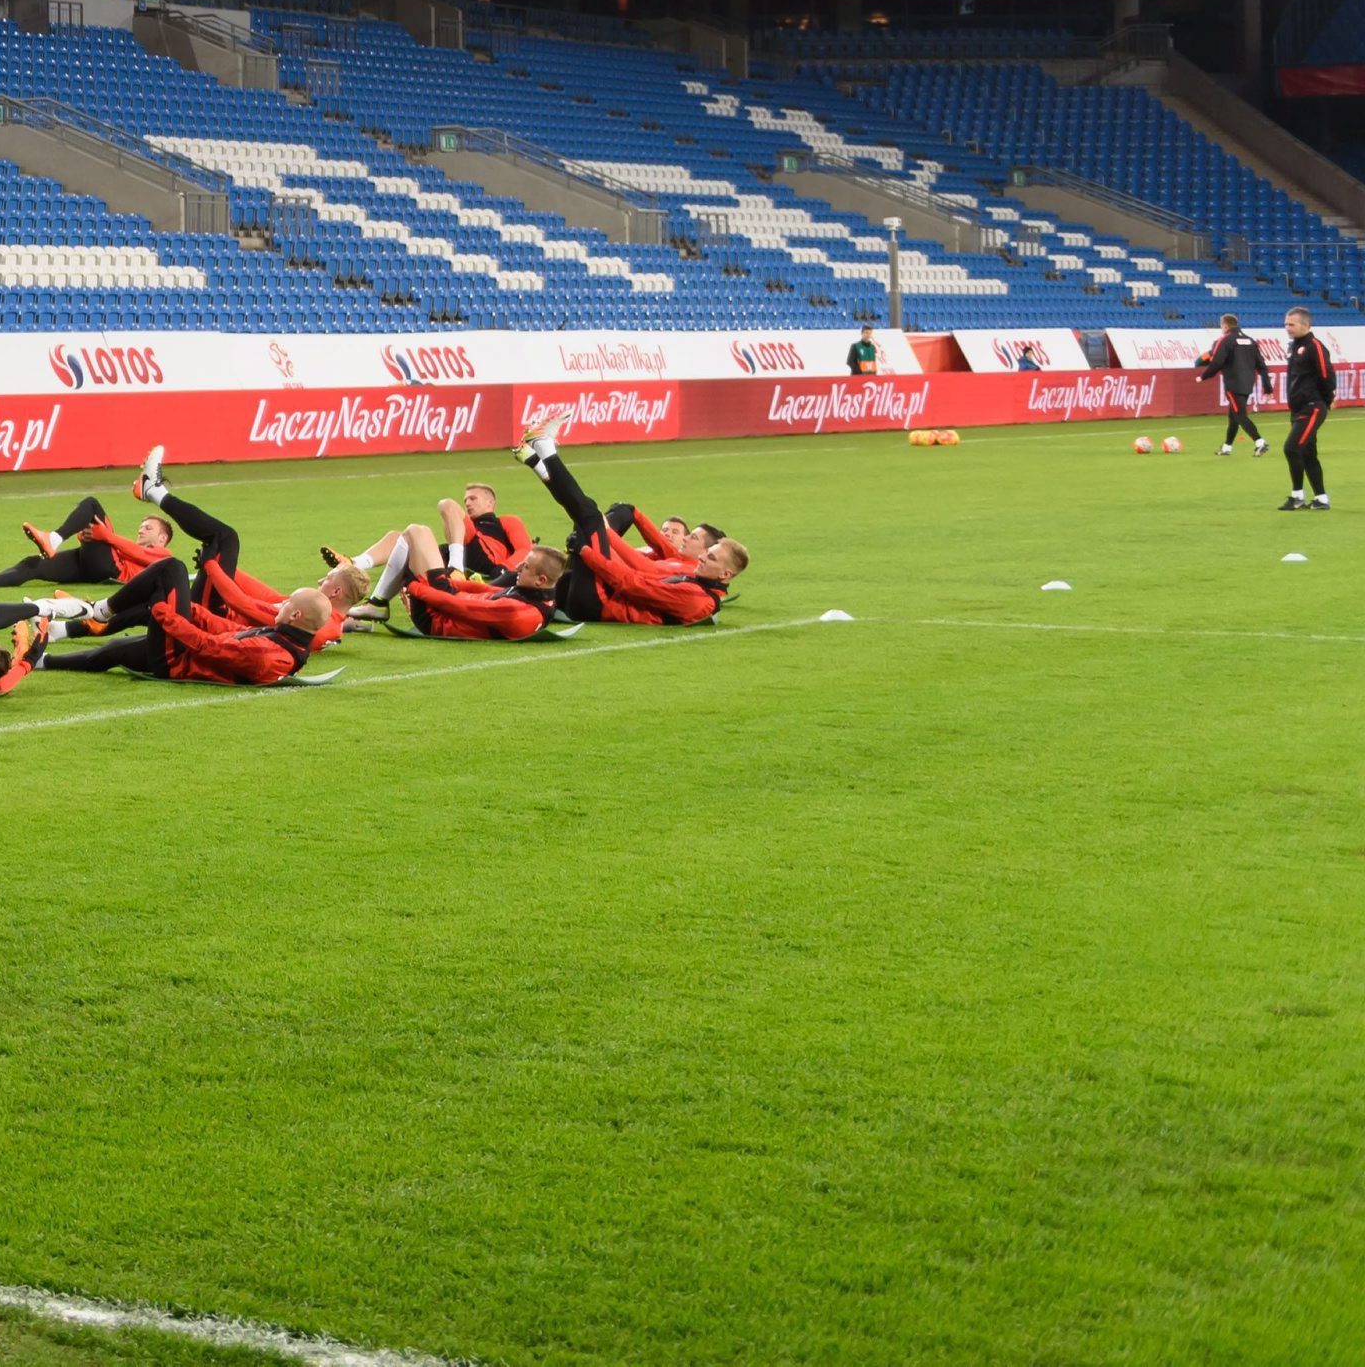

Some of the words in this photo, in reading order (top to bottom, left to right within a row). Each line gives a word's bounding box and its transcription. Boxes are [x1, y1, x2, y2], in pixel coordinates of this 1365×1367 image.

[81, 346, 164, 385] LOTOS
[405, 345, 476, 380] LOTOS
[751, 342, 805, 371] LOTOS
[1256, 338, 1288, 362] OTOS
